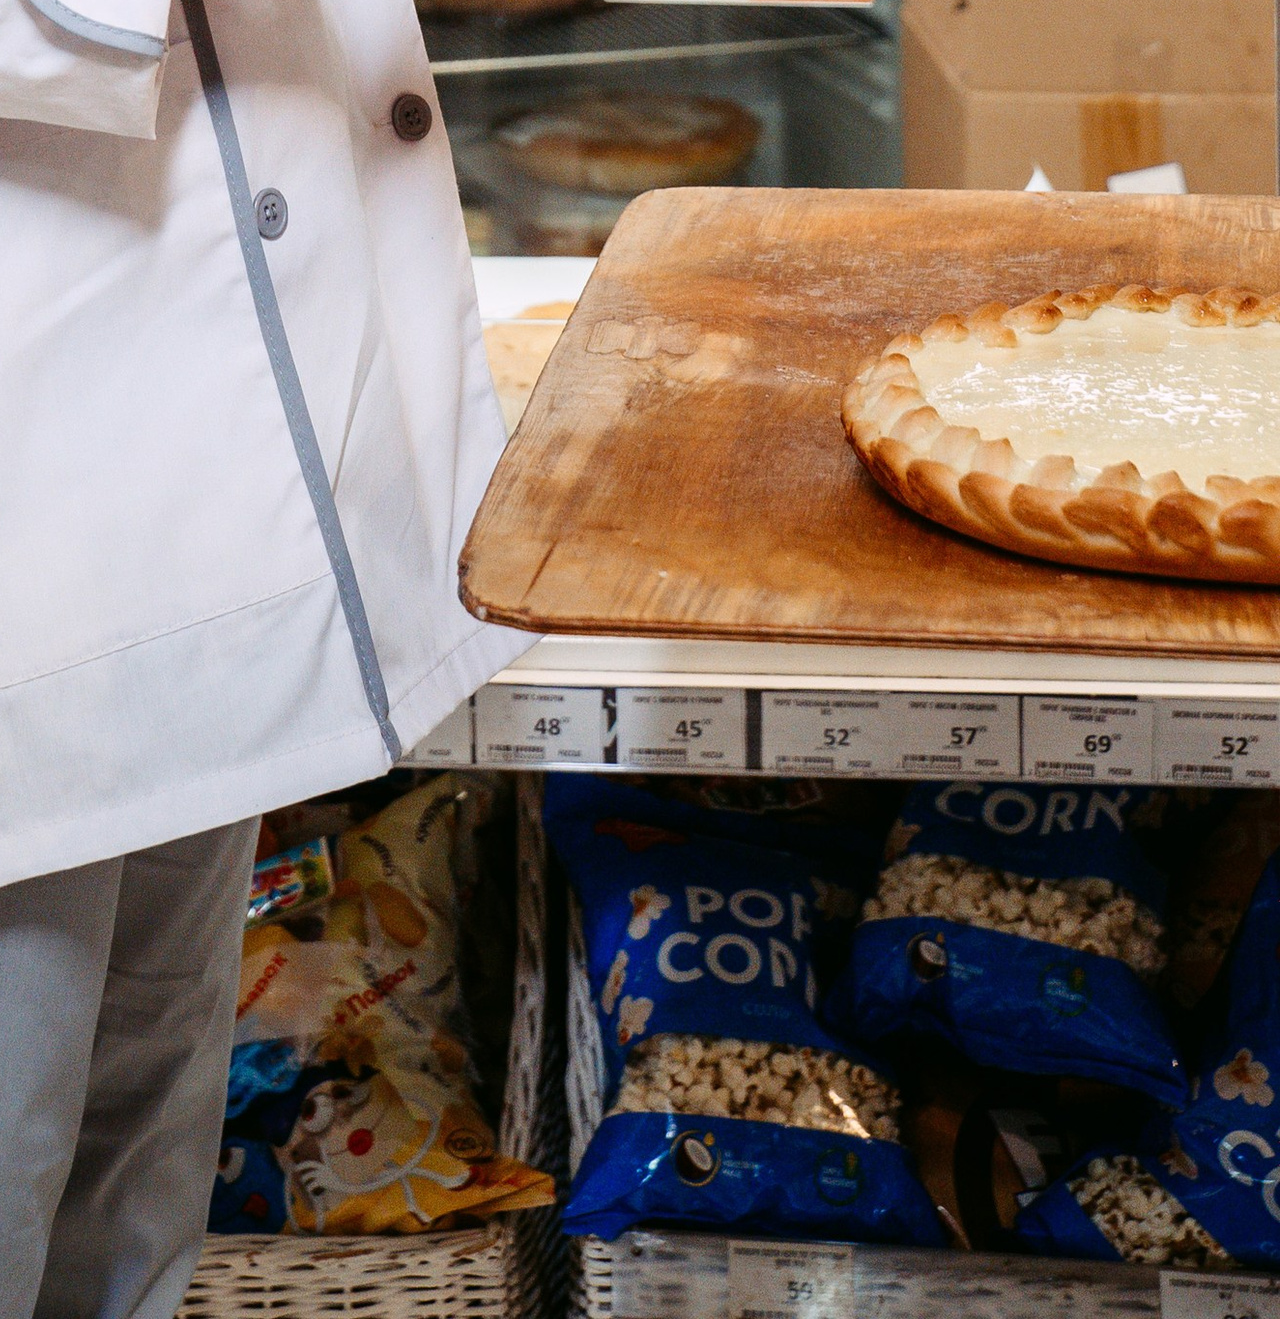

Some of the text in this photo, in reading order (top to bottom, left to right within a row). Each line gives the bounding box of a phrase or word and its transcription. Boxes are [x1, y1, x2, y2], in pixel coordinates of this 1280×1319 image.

[533, 717, 561, 736] 48
[675, 720, 702, 738] 45
[822, 728, 850, 746] 52
[950, 727, 978, 746] 57
[1083, 735, 1112, 753] 69
[1221, 737, 1249, 755] 52
[934, 780, 1131, 837] CORN
